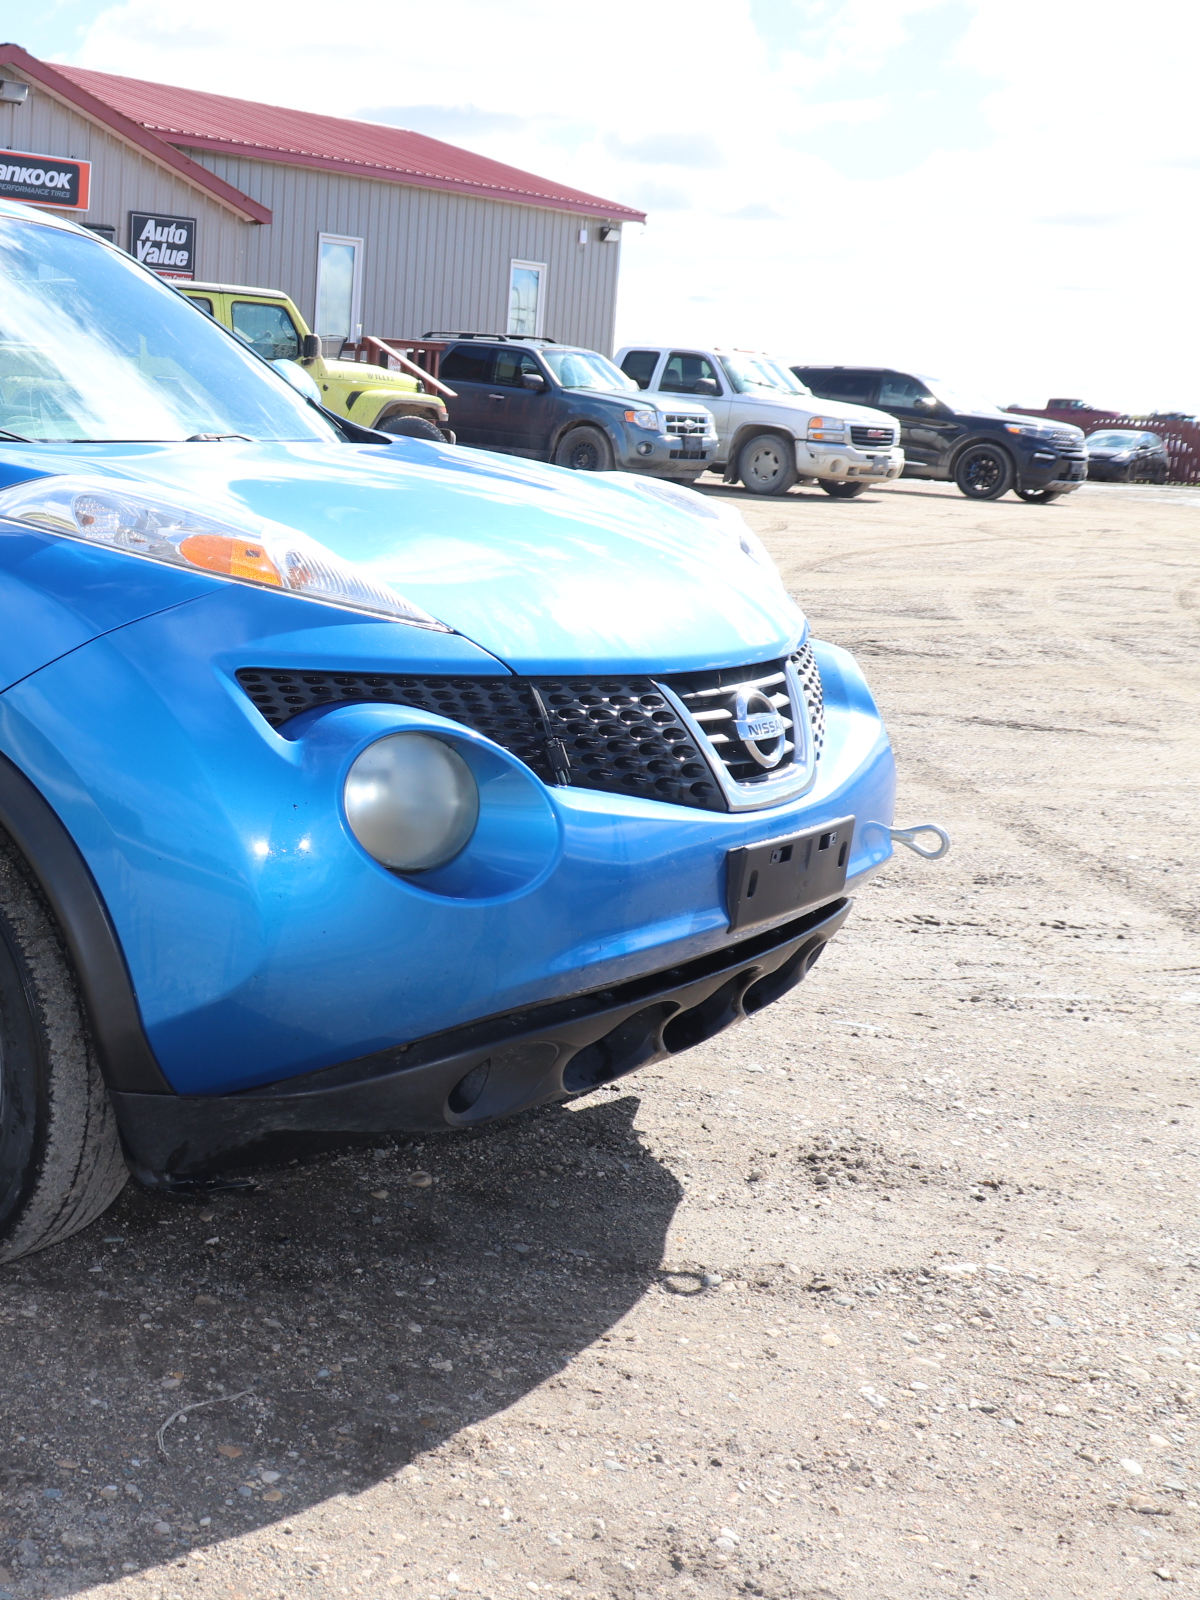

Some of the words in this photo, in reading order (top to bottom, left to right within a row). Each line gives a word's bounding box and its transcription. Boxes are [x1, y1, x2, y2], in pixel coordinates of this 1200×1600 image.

[50, 189, 71, 198] TIRES
[139, 219, 188, 245] Auto
[136, 240, 189, 266] Value
